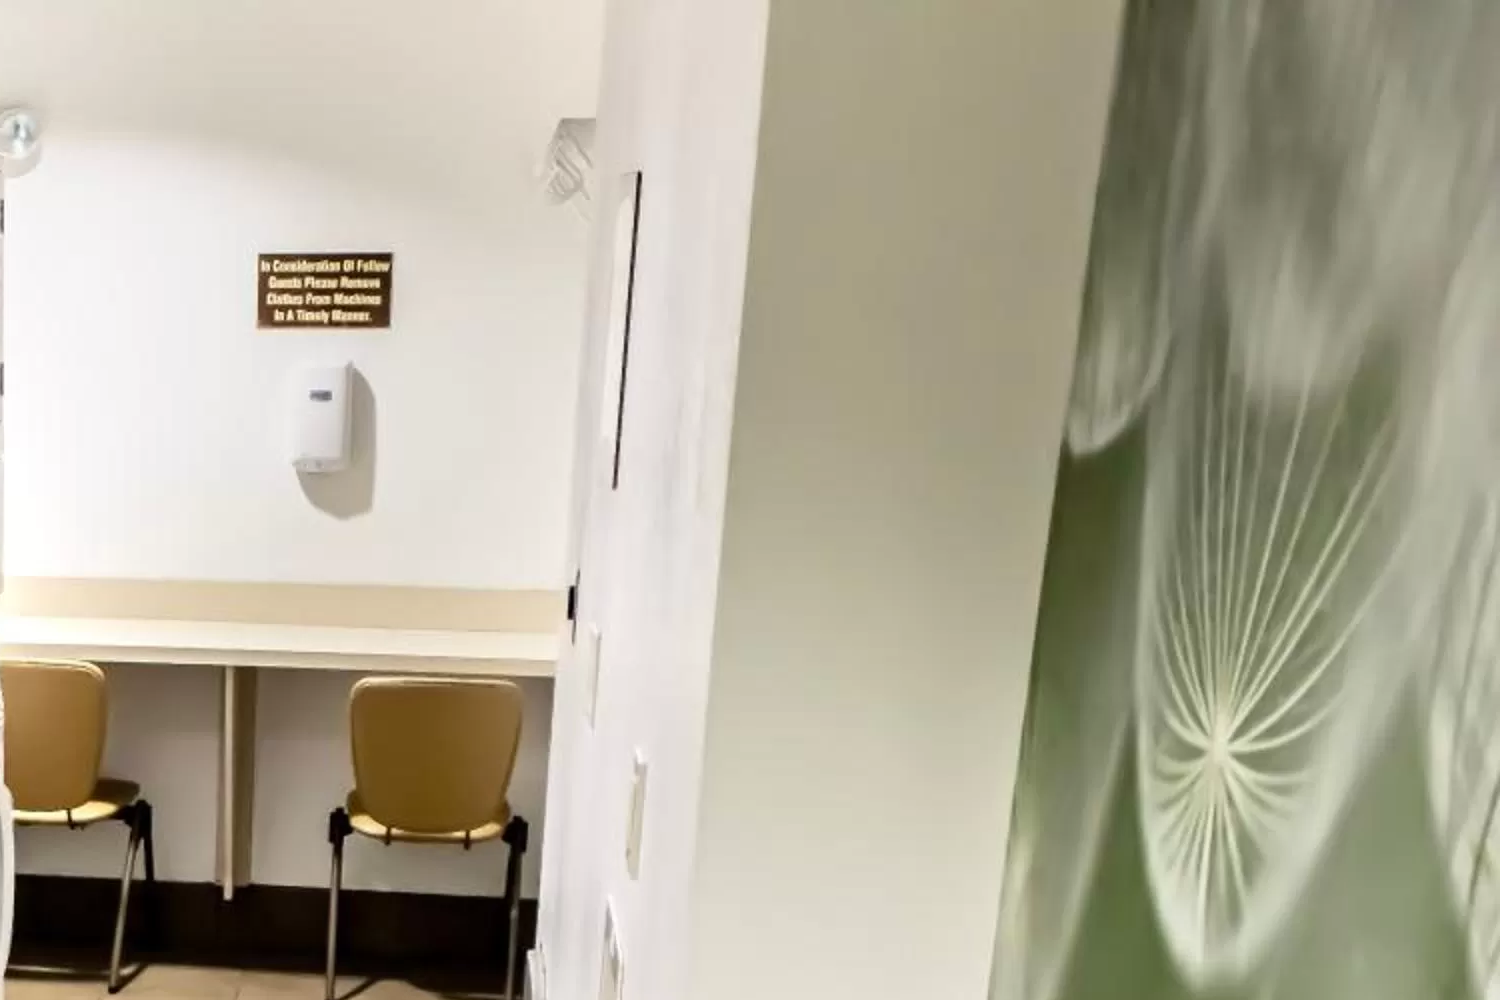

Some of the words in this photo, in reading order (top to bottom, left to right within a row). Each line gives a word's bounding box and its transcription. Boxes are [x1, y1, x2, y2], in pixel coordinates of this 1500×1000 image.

[260, 260, 270, 272] In
[273, 260, 341, 272] Consideration
[343, 260, 354, 272] Of
[357, 260, 390, 272] Fellow
[268, 276, 302, 288] Guests
[304, 276, 338, 288] Please
[340, 276, 381, 288] Remove
[266, 293, 304, 305] Clothes
[306, 293, 332, 305] From
[333, 293, 382, 305] Machines
[274, 309, 285, 321] In
[286, 309, 295, 321] A
[296, 309, 329, 323] Timely
